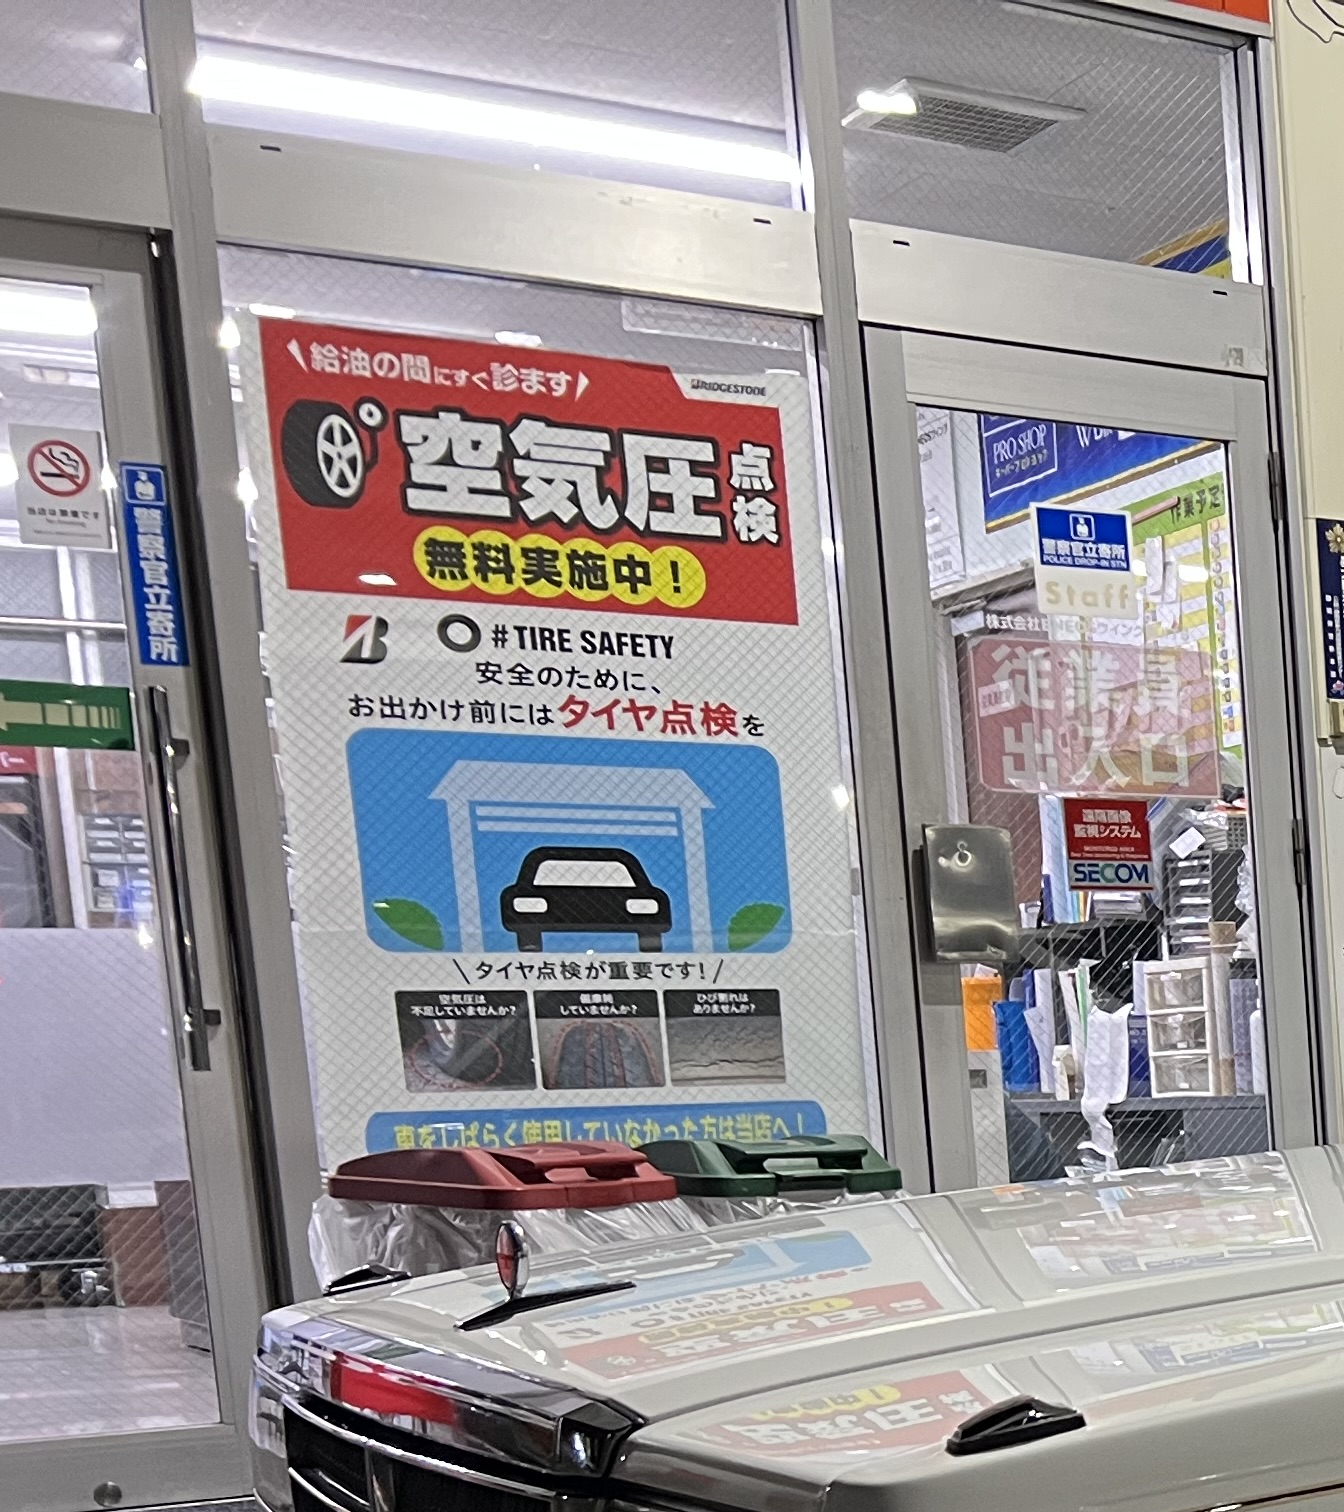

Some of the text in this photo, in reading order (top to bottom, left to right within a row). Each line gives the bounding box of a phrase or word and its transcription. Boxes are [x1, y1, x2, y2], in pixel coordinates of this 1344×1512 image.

[309, 342, 574, 397] 給油の間にすぐ診ます
[689, 377, 767, 398] BRIDGESTONE
[993, 423, 1047, 465] PRO SHOP
[398, 408, 727, 542] 空気圧
[728, 442, 781, 545] 点検
[1043, 554, 1073, 565] POLICE
[1110, 560, 1127, 569] STN
[132, 506, 178, 664] 警察官立寄所
[1045, 580, 1129, 609] Staff
[513, 625, 573, 653] TIRE
[580, 629, 675, 660] SAFETY
[475, 660, 662, 695] 安全のために、
[347, 693, 766, 738] お出かけ前にはタイヤ点検を
[1001, 721, 1190, 789] 出入口
[1073, 862, 1149, 884] SECOM
